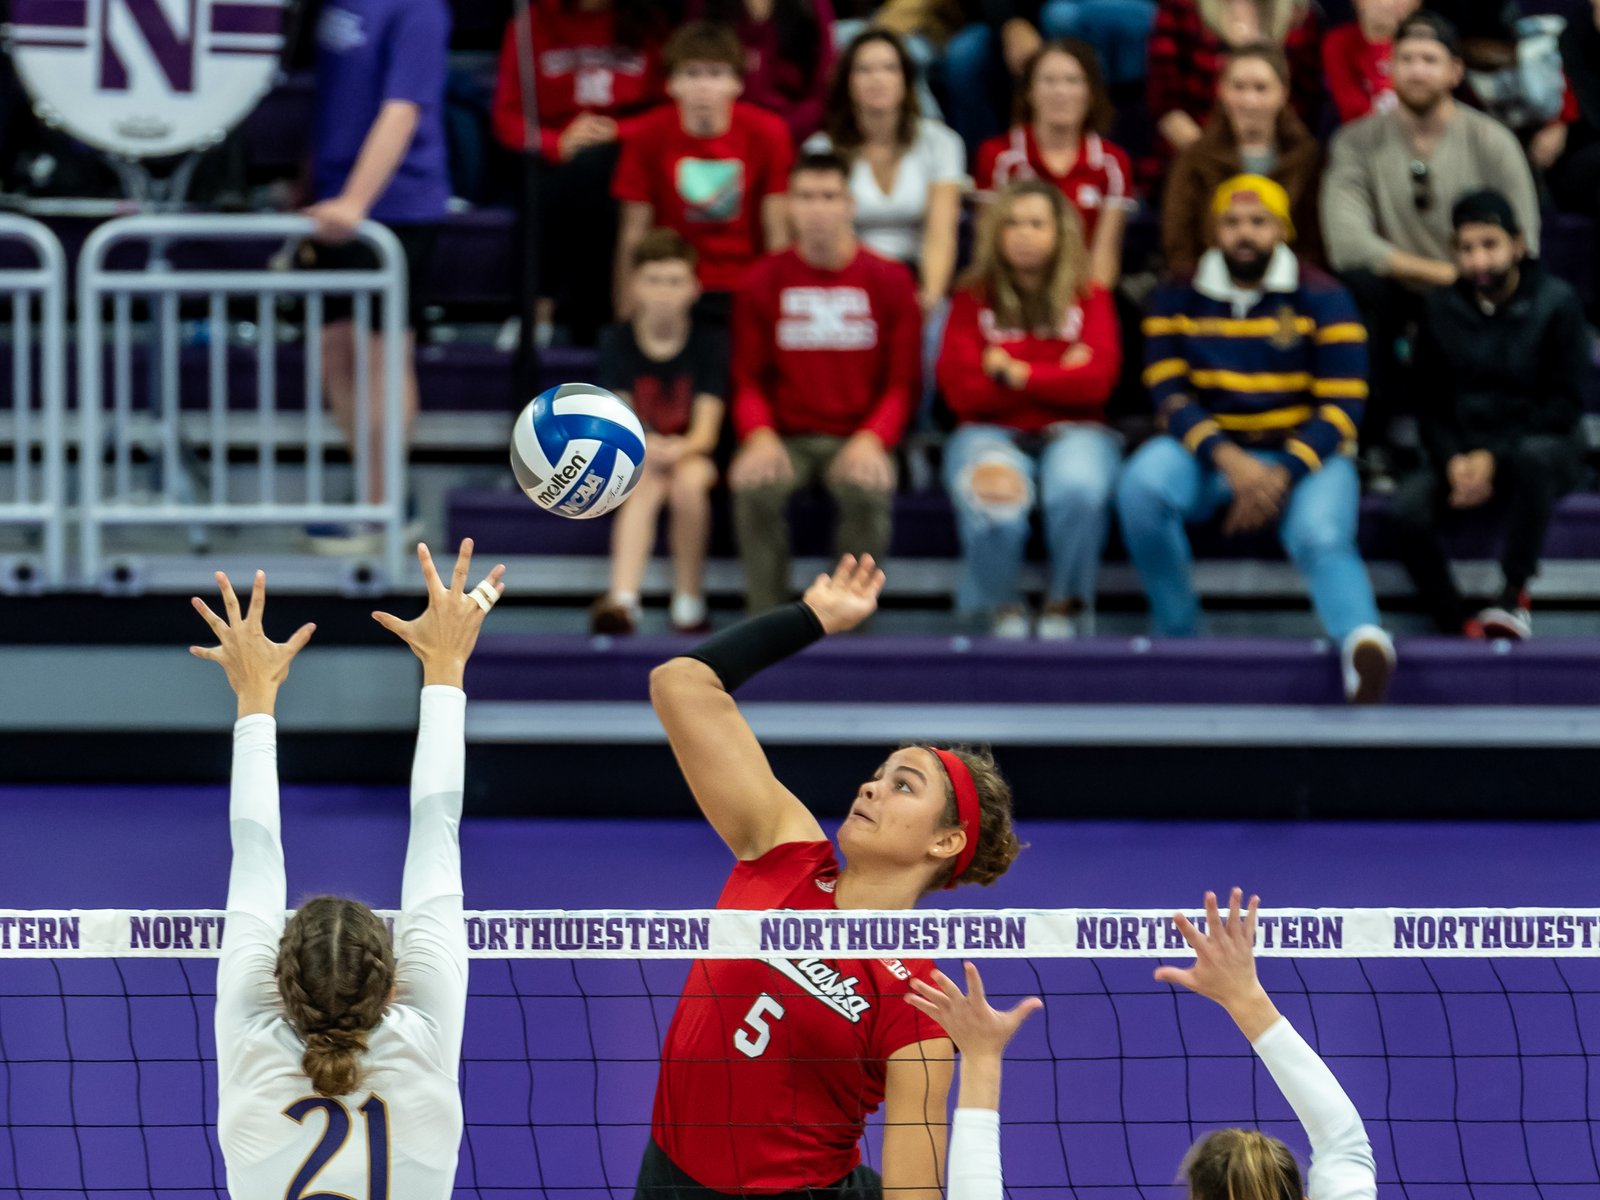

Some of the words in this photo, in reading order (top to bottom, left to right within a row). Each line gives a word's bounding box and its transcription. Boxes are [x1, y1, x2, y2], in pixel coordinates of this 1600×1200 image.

[537, 454, 588, 506] molten
[558, 472, 606, 515] NCAA
[463, 916, 710, 950] ORTHWESTERN
[759, 916, 1026, 951] NORTHWESTERN
[1076, 915, 1344, 950] NORTHTERN
[1393, 915, 1600, 950] NORTHWEST
[734, 991, 785, 1058] 5
